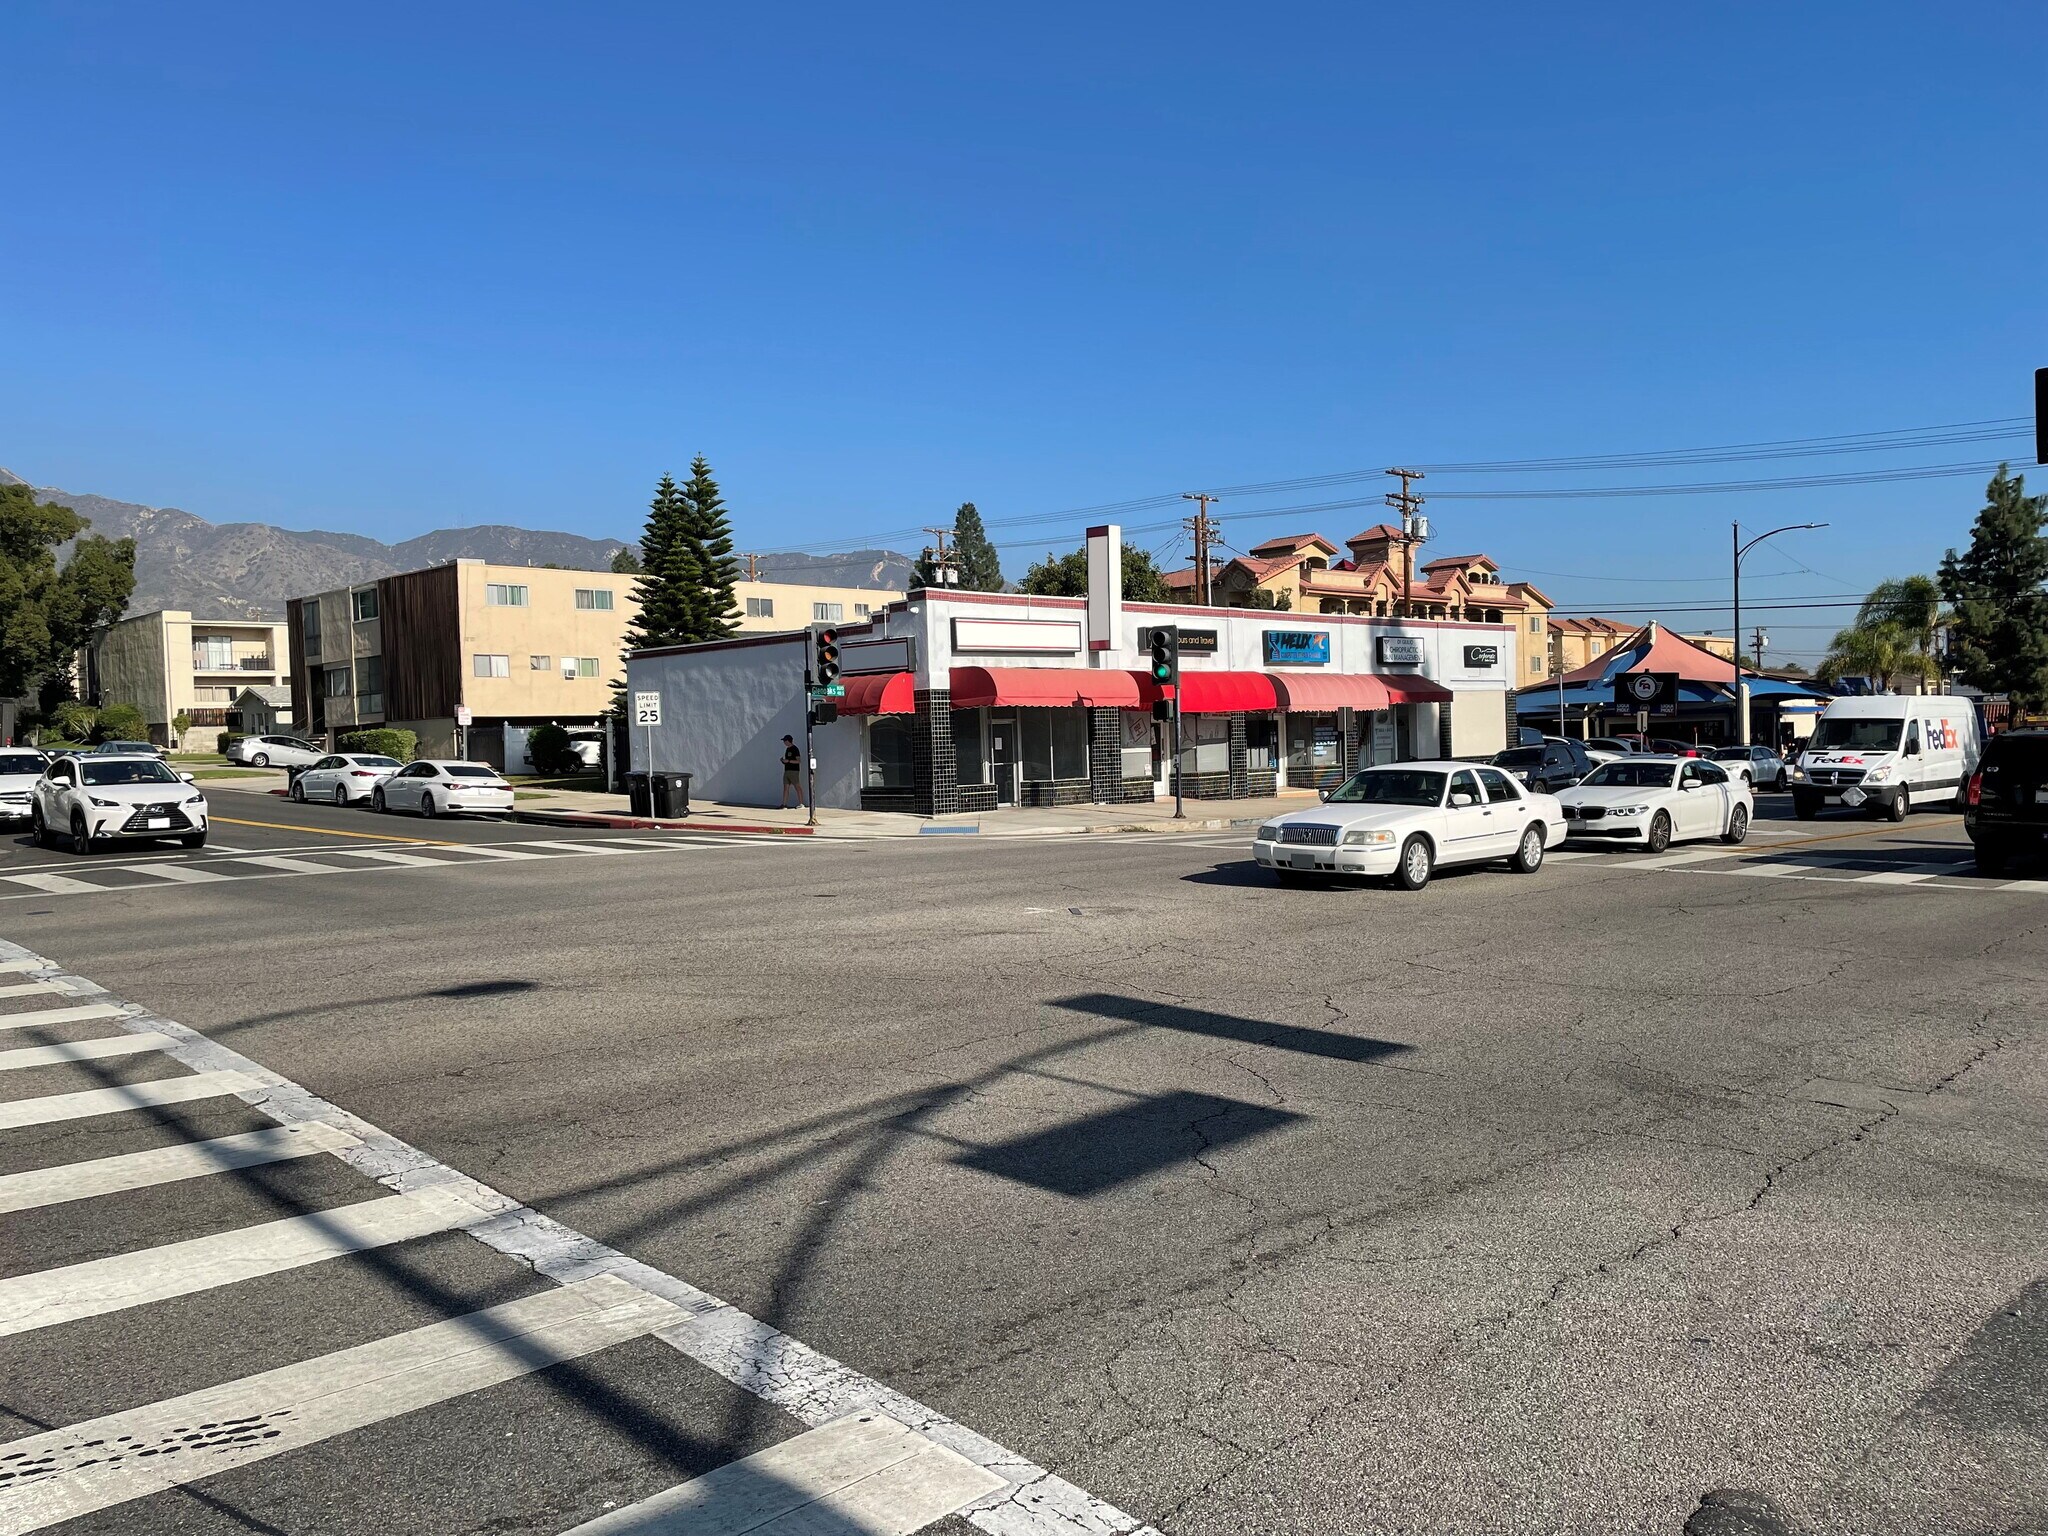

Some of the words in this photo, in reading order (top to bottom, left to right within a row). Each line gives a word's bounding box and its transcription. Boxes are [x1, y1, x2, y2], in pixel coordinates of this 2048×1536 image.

[1188, 636, 1200, 644] and
[1200, 636, 1214, 645] Travel
[1281, 633, 1312, 649] HELIX
[639, 710, 658, 722] 25
[1925, 719, 1959, 750] FedEx
[1812, 755, 1866, 765] FedEx
